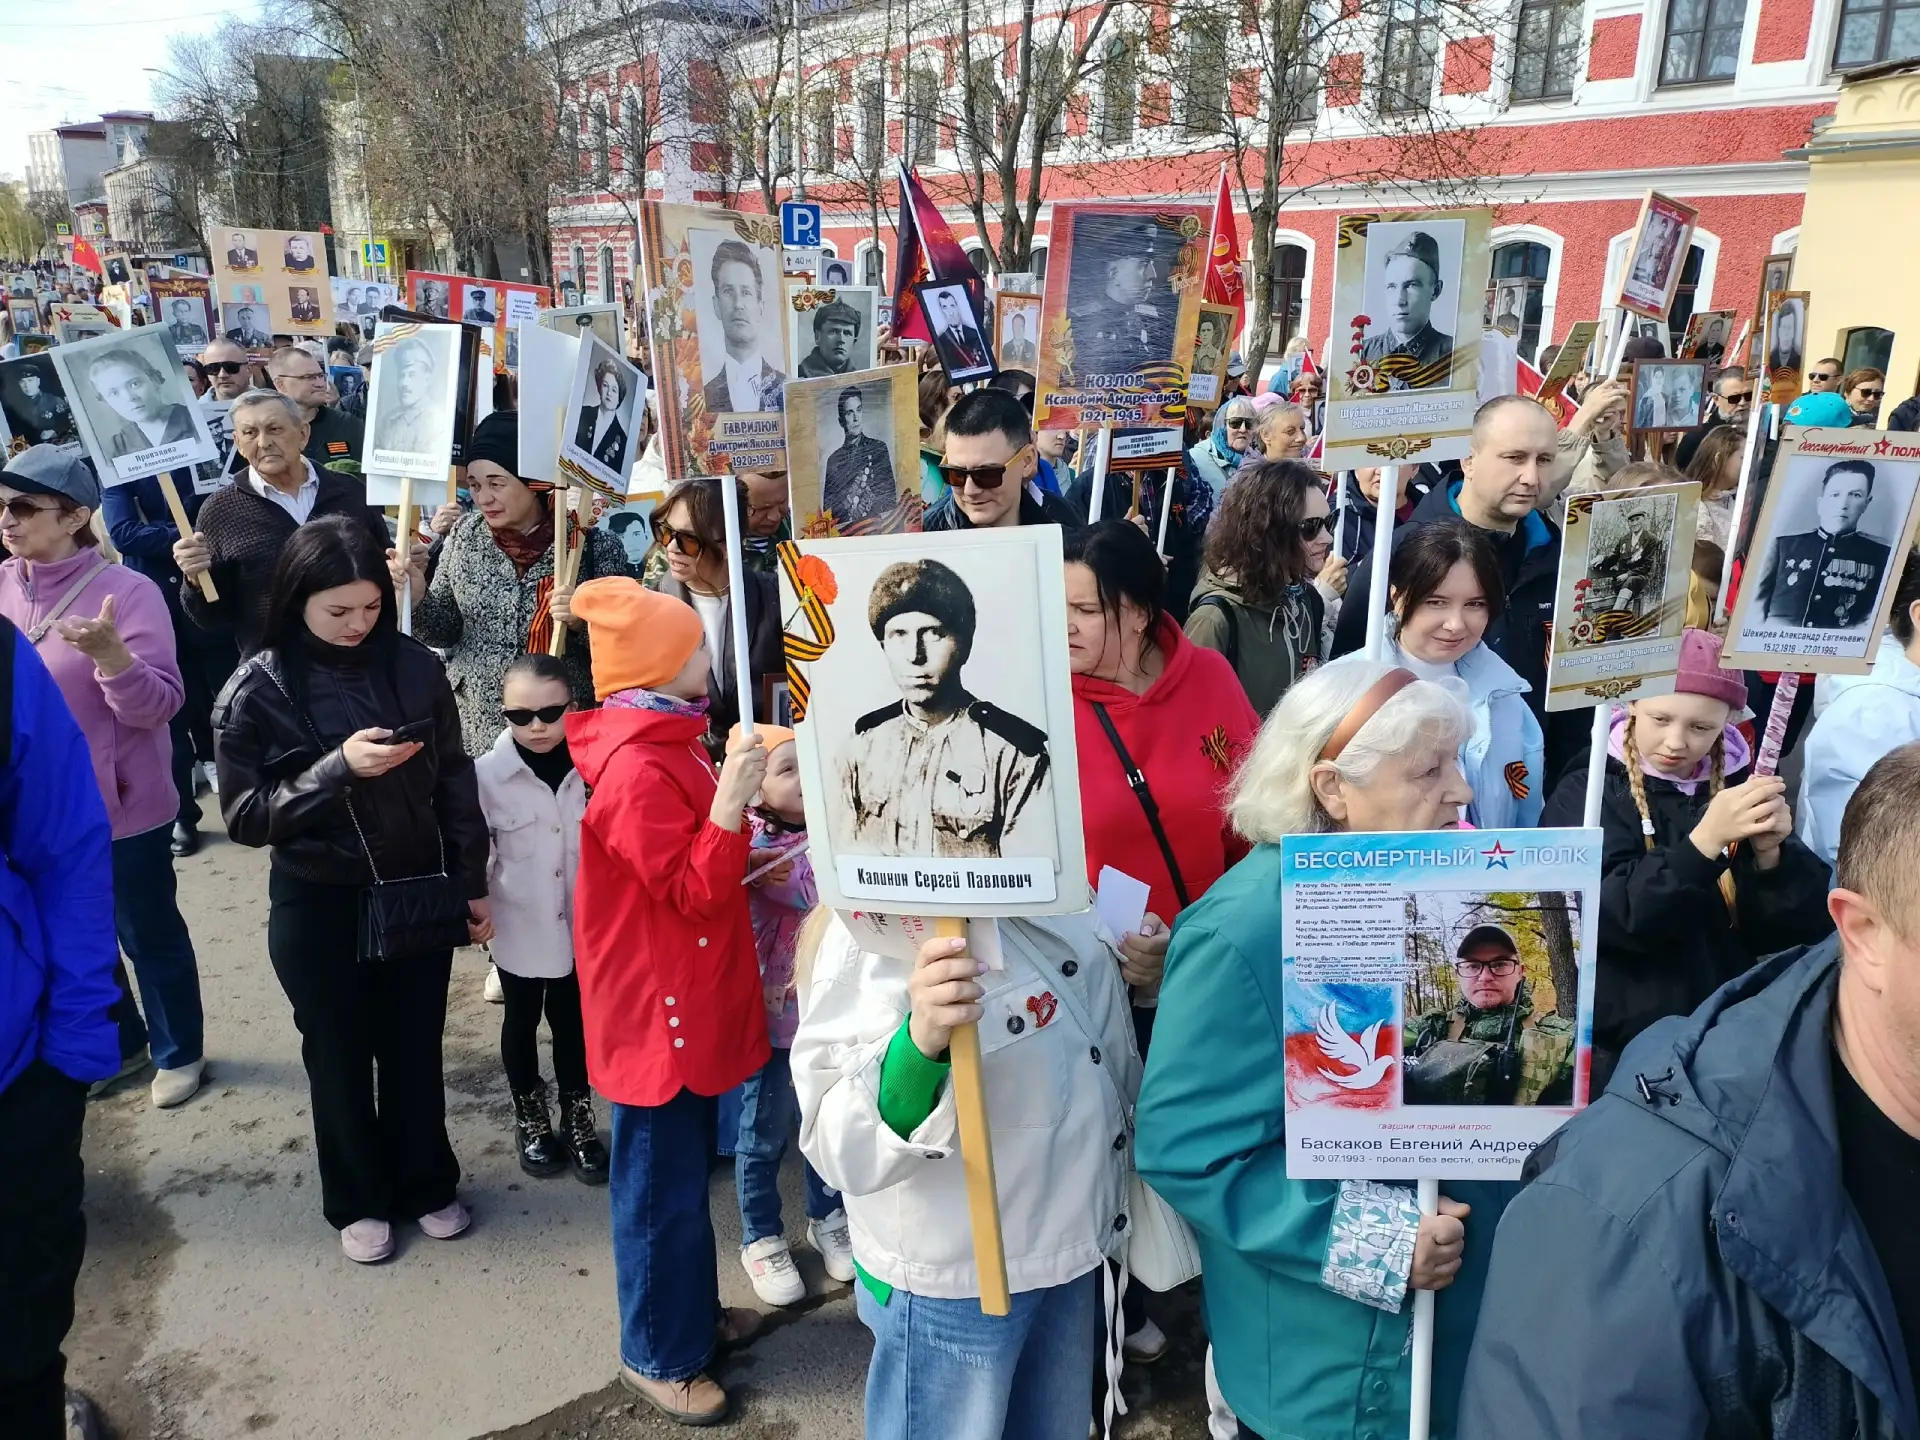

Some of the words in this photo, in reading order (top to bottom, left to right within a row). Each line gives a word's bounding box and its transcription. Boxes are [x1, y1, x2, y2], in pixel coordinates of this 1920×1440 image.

[793, 207, 815, 242] P
[794, 256, 805, 265] 40
[187, 290, 206, 298] 1945
[1085, 374, 1144, 388] КОЗЛОВ
[1045, 392, 1104, 406] Ксанфий
[1106, 392, 1180, 406] Андреевич
[1079, 409, 1142, 422] 1921-1945
[1340, 408, 1371, 420] Шубин
[1373, 404, 1411, 416] Василий
[723, 420, 779, 436] ГАВРИЛЮК
[709, 439, 749, 454] Дмитрий
[732, 453, 775, 468] 1920-1997
[1742, 628, 1778, 640] Шехирев
[1779, 630, 1821, 642] Александр
[1822, 632, 1866, 643] Евгеньевич
[1294, 845, 1476, 869] БЕССМЕРТНЫЙ
[1521, 846, 1588, 866] ПОЛК
[857, 868, 909, 888] Калинин
[914, 870, 961, 892] Сергей
[966, 871, 1033, 889] Павлович
[1378, 1123, 1415, 1131] гвардии
[1417, 1123, 1456, 1131] старший
[1458, 1123, 1492, 1131] матрос
[1301, 1137, 1383, 1150] Баскаков
[1390, 1137, 1463, 1150] Евгений
[1312, 1154, 1365, 1164] 30.07.1993
[1376, 1156, 1415, 1164] пропал
[1418, 1155, 1437, 1163] без
[1440, 1156, 1474, 1165] вести,
[1477, 1155, 1521, 1165] октябрь
